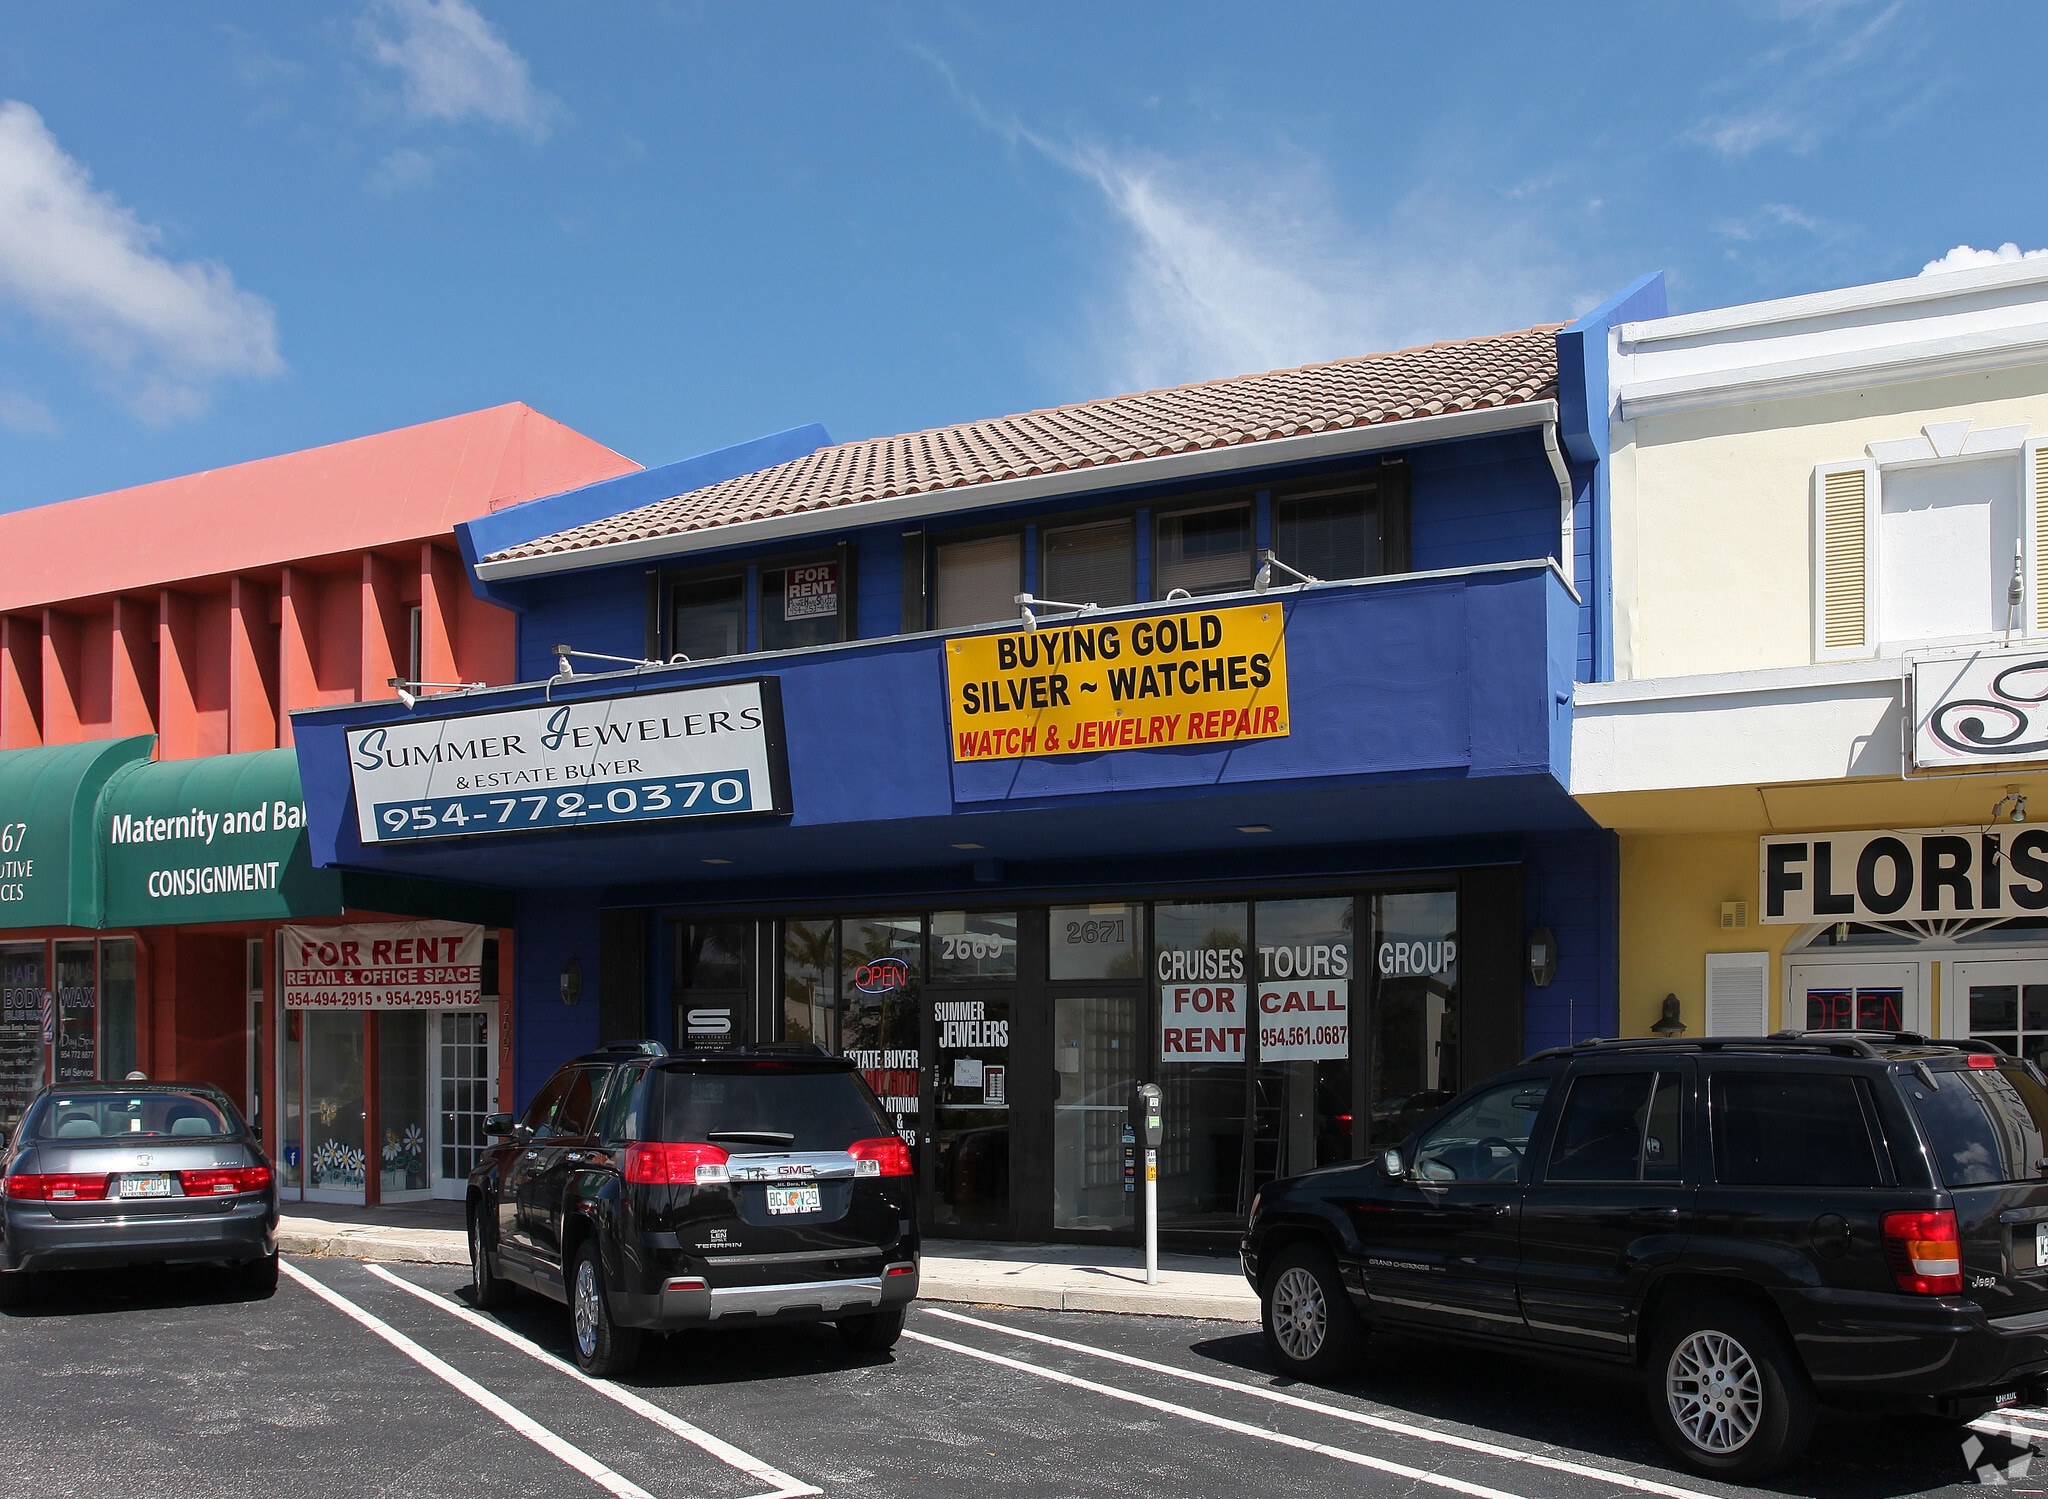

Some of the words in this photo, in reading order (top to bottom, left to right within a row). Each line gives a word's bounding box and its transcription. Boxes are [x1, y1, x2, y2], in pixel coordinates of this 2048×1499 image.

[795, 567, 830, 583] FOR
[789, 580, 835, 598] RENT
[997, 627, 1121, 671] BUYING
[1132, 615, 1223, 657] GOLD
[962, 674, 1071, 715] SILVER
[1107, 654, 1272, 701] WATCHES
[353, 728, 527, 772] SUMMER
[540, 705, 763, 752] JEWELERS
[959, 726, 1037, 757] WATCH
[1044, 724, 1060, 751] &
[1067, 714, 1182, 750] JEWELRY
[1187, 705, 1280, 740] REPAIR
[456, 776, 470, 790] &
[474, 767, 557, 789] ESTATE
[564, 758, 643, 780] BUYER
[382, 777, 745, 833] 954-772-0370
[111, 807, 220, 846] Maternity
[222, 801, 267, 834] and
[148, 861, 280, 899] CONSIGNMENT
[1767, 830, 2048, 917] FLORIS
[1066, 920, 1125, 944] 2671
[302, 941, 361, 967] FOR
[372, 937, 463, 965] RENT
[942, 933, 1004, 961] 2669
[1158, 948, 1244, 981] CRUISES
[1259, 944, 1349, 978] TOURS
[1378, 941, 1457, 974] GROUP
[4, 963, 38, 983] HAIR
[287, 970, 340, 985] RETAIL
[344, 970, 355, 984] &
[360, 969, 418, 984] OFFICE
[423, 967, 481, 983] SPACE
[854, 965, 908, 987] OPEN
[3, 987, 46, 1009] BODY
[59, 987, 95, 1008] WAX
[287, 990, 374, 1007] 954-494-2915
[385, 989, 481, 1006] 954-295-9152
[1174, 988, 1236, 1013] FOR
[1260, 990, 1347, 1013] CALL
[934, 1001, 986, 1022] SUMMER
[60, 1033, 77, 1049] Day
[78, 1033, 94, 1050] Spa
[501, 1000, 511, 1063] 2667
[939, 1020, 1010, 1048] JEWELERS
[1164, 1028, 1246, 1053] RENT
[1260, 1025, 1348, 1047] 954.561.0687
[60, 1051, 70, 1059] 954
[71, 1051, 81, 1059] 772
[82, 1051, 94, 1059] 8877
[884, 1049, 919, 1069] BUYER
[60, 1068, 71, 1077] Full
[72, 1068, 94, 1077] Service
[865, 1070, 885, 1096] BUY
[889, 1070, 917, 1096] GOLD
[878, 1096, 919, 1113] ATINUM
[896, 1113, 904, 1130] &
[778, 1165, 812, 1175] GMC
[769, 1192, 788, 1207] BGJ
[801, 1191, 818, 1205] V29
[1368, 1258, 1393, 1267] GRAND
[1393, 1261, 1430, 1272] CHEROKEE
[1972, 1275, 1996, 1289] Jeep
